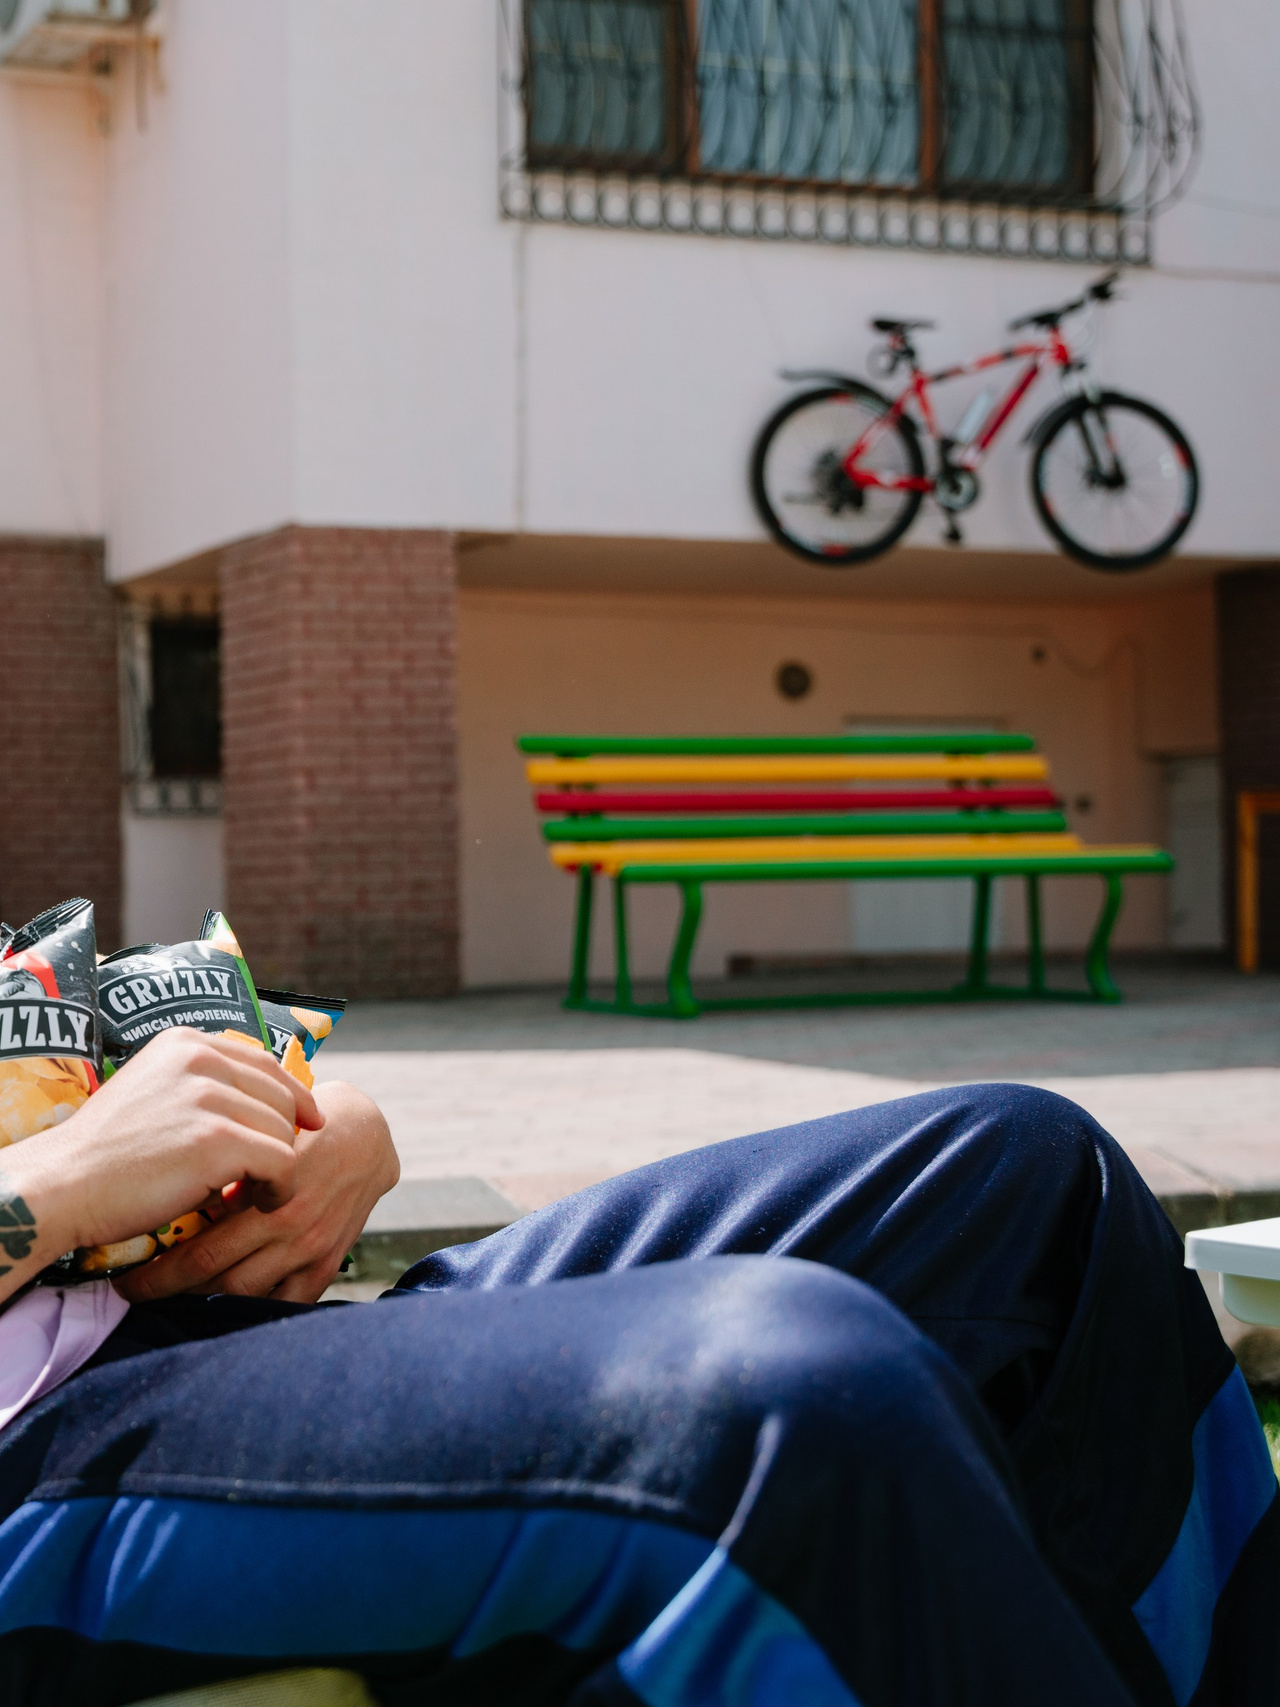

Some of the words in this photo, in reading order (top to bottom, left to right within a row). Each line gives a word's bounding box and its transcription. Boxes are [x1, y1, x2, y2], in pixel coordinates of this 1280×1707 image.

[108, 970, 232, 1014] GRIZZLY
[120, 1016, 174, 1042] ЧИПСЫ
[174, 1009, 247, 1025] РИФЛЕНЫЕ
